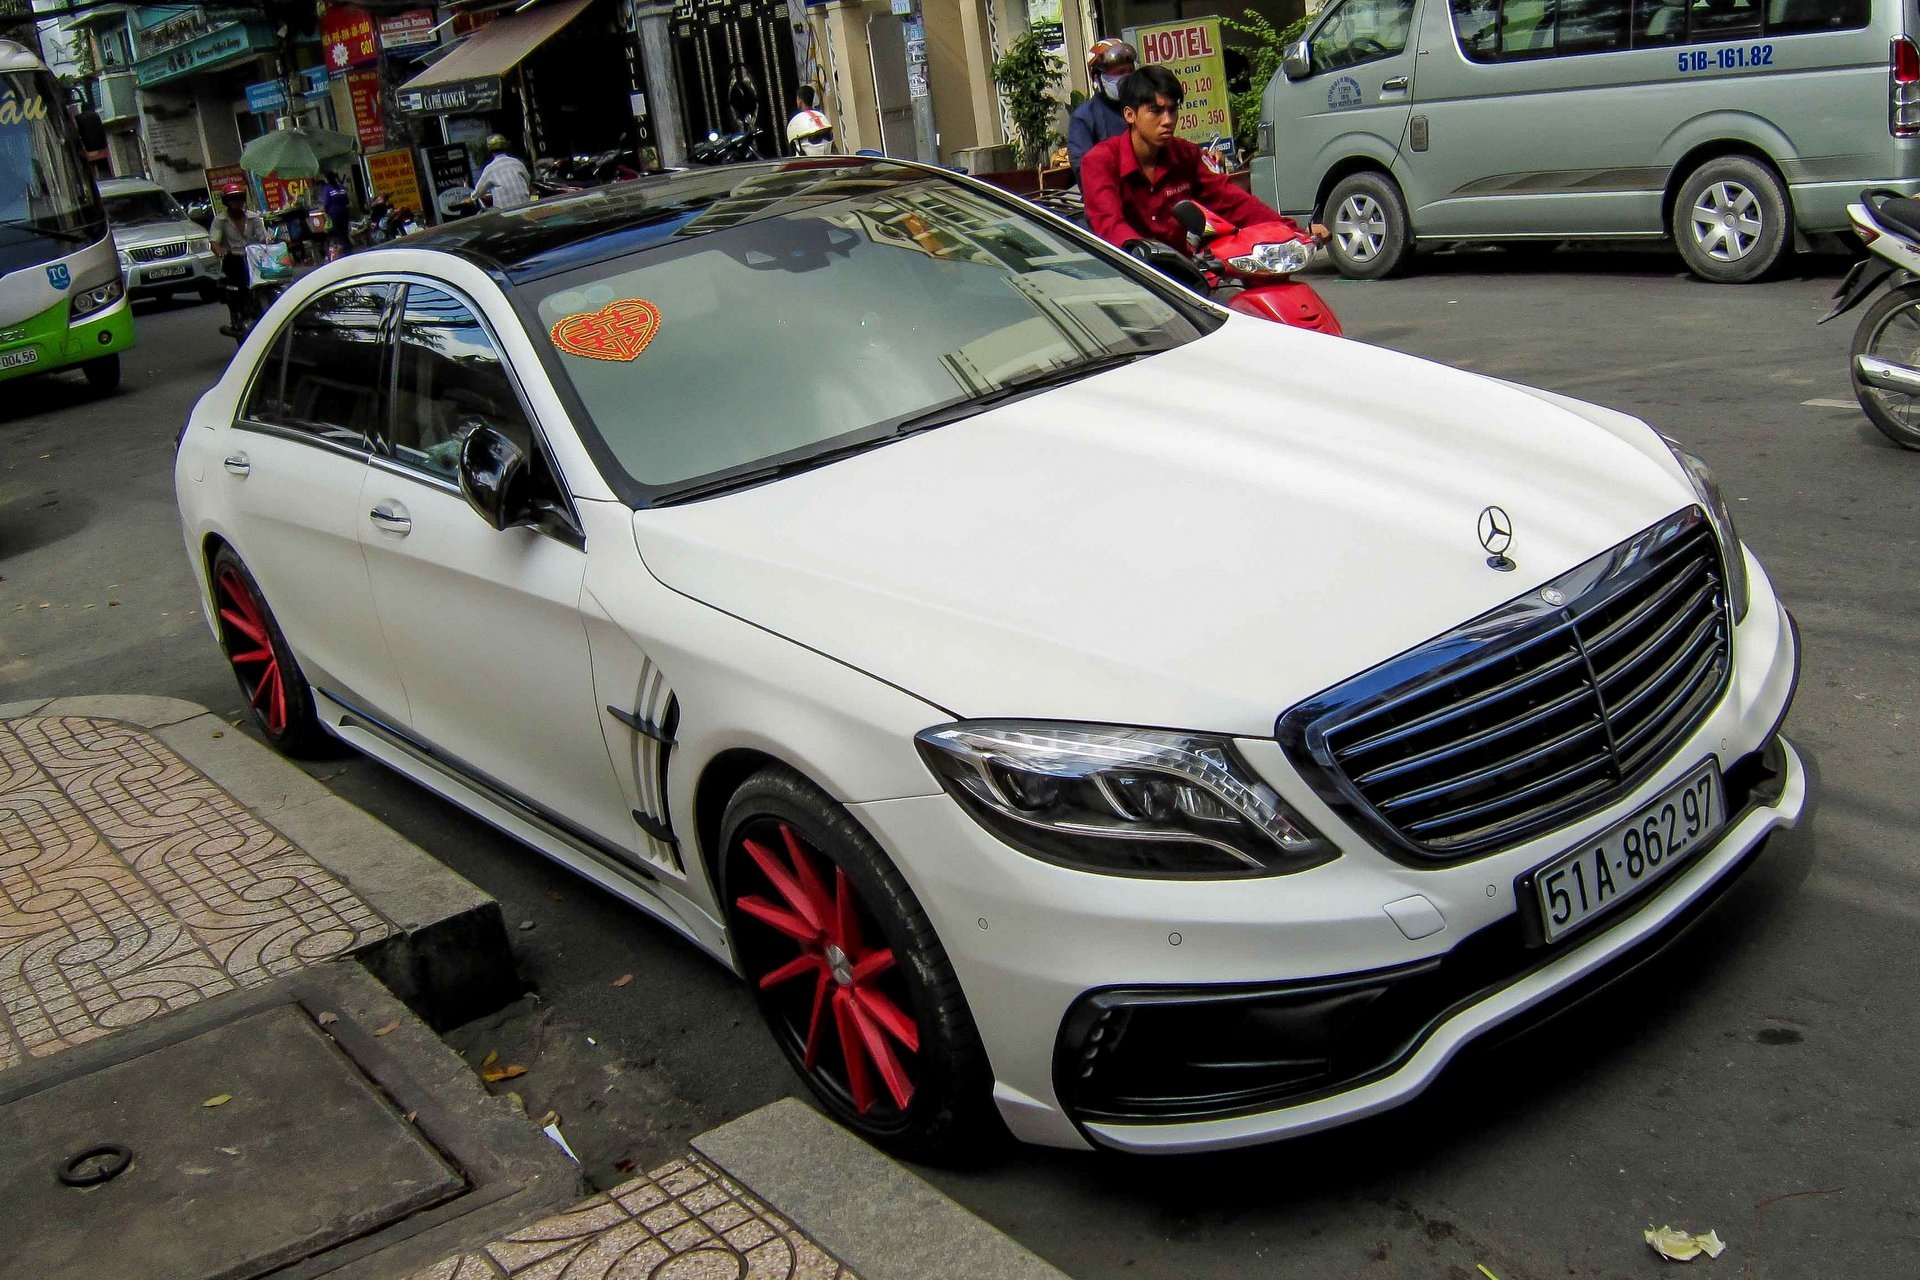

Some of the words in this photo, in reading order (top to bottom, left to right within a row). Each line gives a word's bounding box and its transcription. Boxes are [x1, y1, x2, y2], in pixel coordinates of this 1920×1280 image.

[1142, 26, 1214, 64] HOTEL
[1679, 45, 1773, 72] 51B-161.82
[1195, 77, 1212, 93] 120
[1180, 112, 1198, 130] 250
[1207, 109, 1225, 125] 350
[1546, 774, 1712, 925] 51A-862.97
